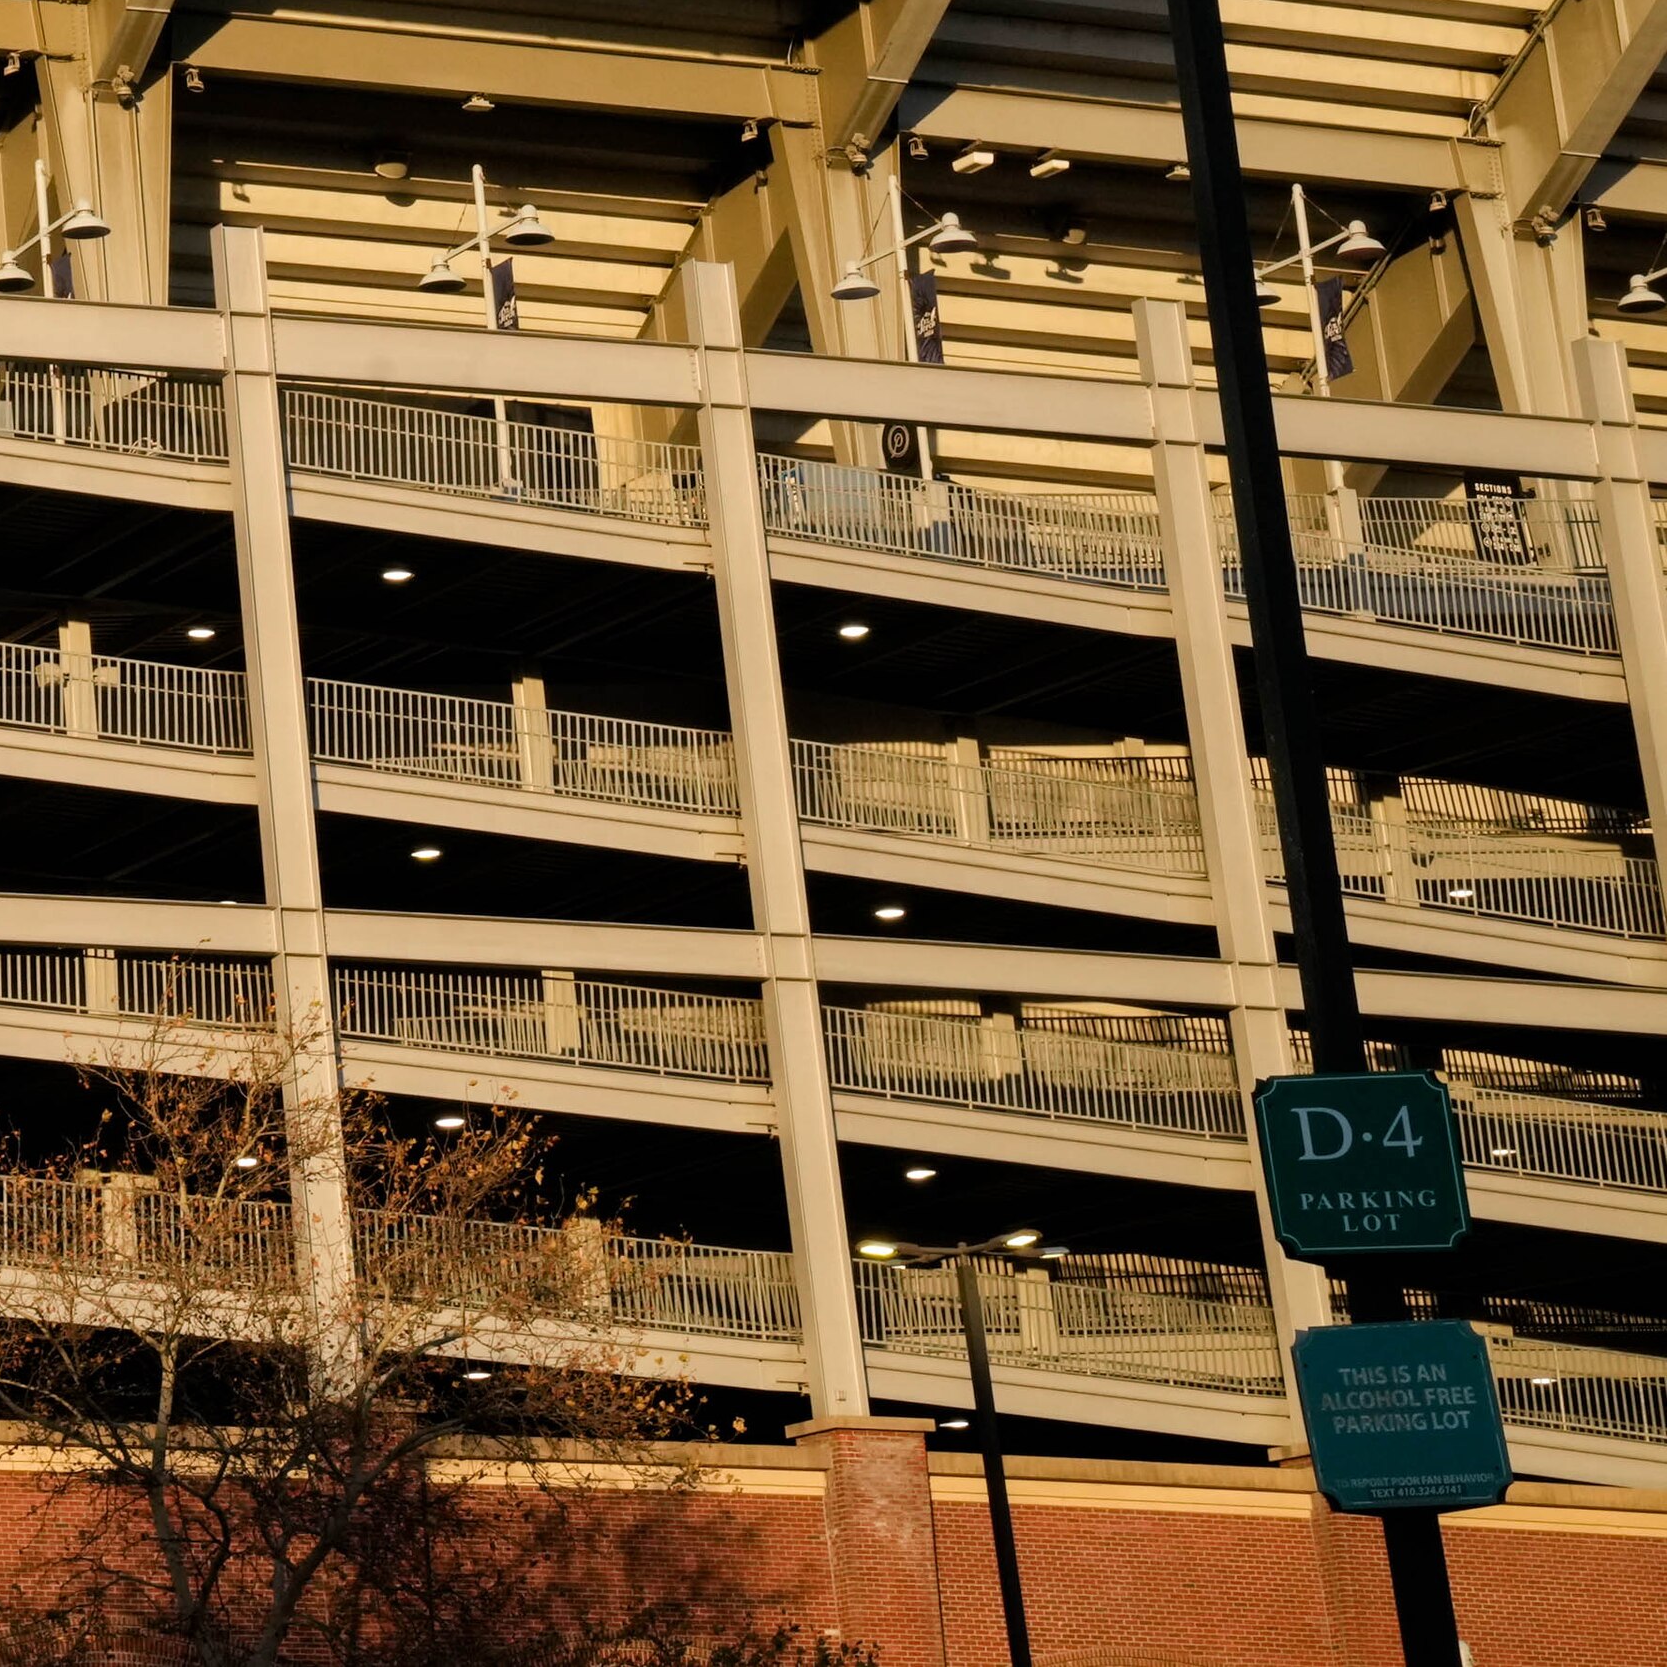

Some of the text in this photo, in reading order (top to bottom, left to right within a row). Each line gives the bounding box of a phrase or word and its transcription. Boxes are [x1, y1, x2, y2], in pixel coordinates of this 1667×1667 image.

[1474, 483, 1512, 494] SECTIONS
[1300, 1190, 1437, 1211] PARKING
[1343, 1214, 1400, 1232] LOT
[1338, 1364, 1447, 1386] THIS IS AN
[1321, 1386, 1478, 1411] ALCOHOL FREE
[1332, 1411, 1471, 1434] PARKING LOT
[1351, 1476, 1391, 1488] REPORT
[1391, 1476, 1422, 1486] POOR
[1422, 1474, 1443, 1484] FAN
[1370, 1484, 1463, 1498] TEXT 410.324.6141
